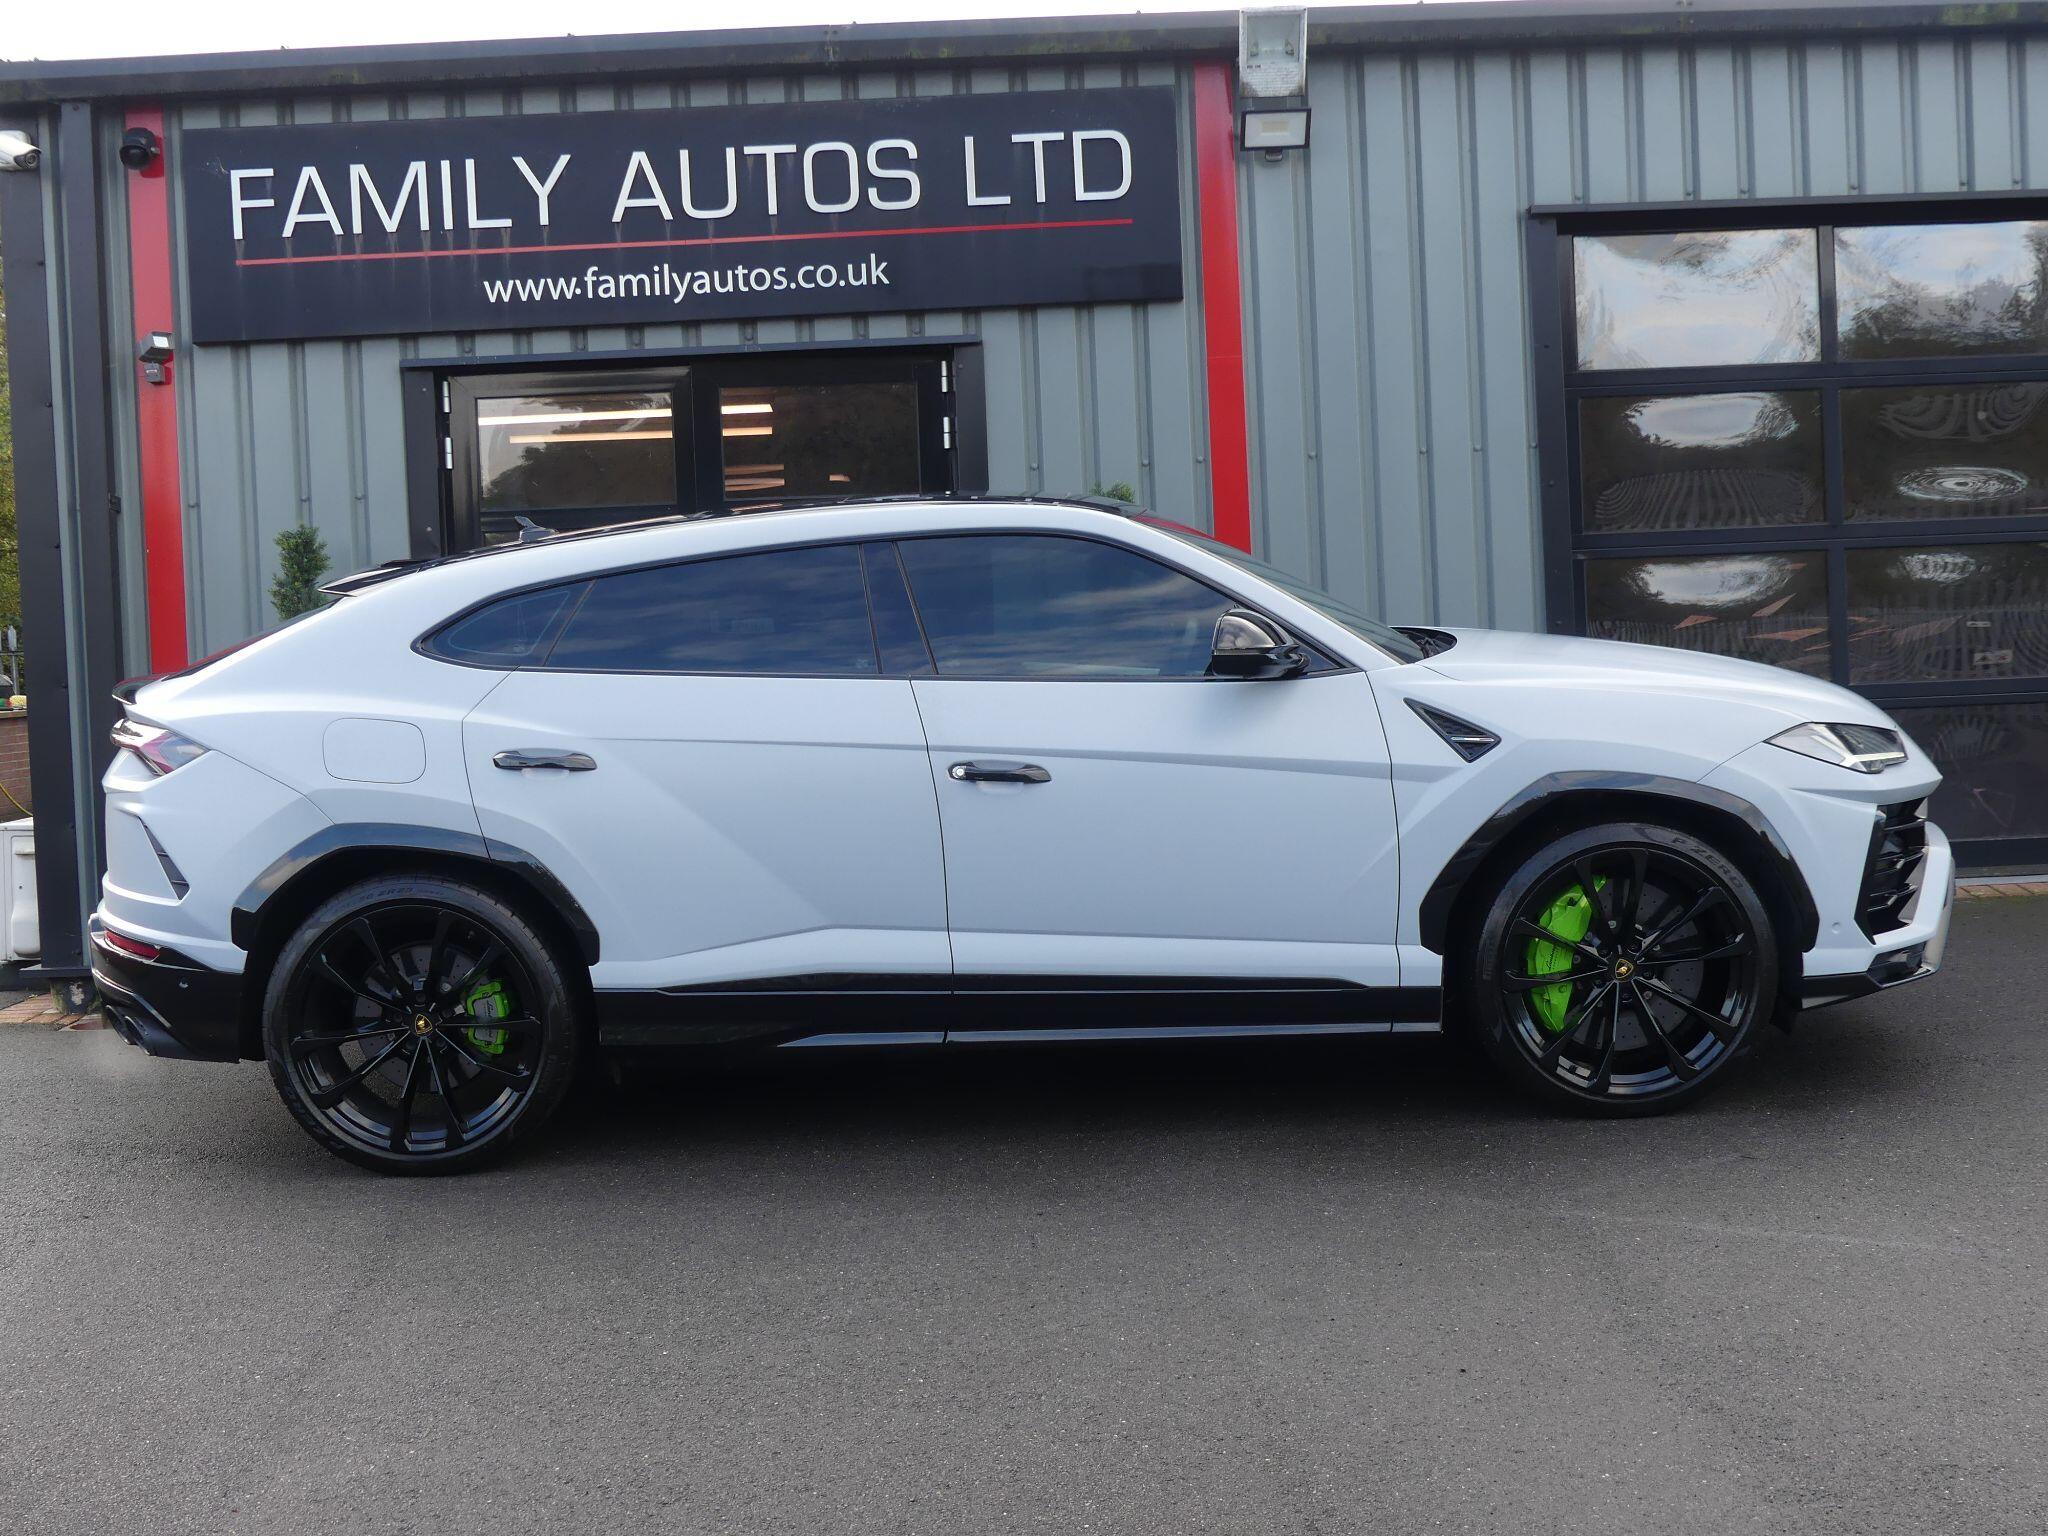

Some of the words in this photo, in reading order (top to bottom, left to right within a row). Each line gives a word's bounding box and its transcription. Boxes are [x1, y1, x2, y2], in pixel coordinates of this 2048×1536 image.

[229, 153, 572, 240] FAMILY
[611, 138, 921, 223] AUTOS
[964, 129, 1132, 207] LTD
[483, 253, 890, 303] www.familyautos.co.uk
[1690, 845, 1744, 888] ZERO
